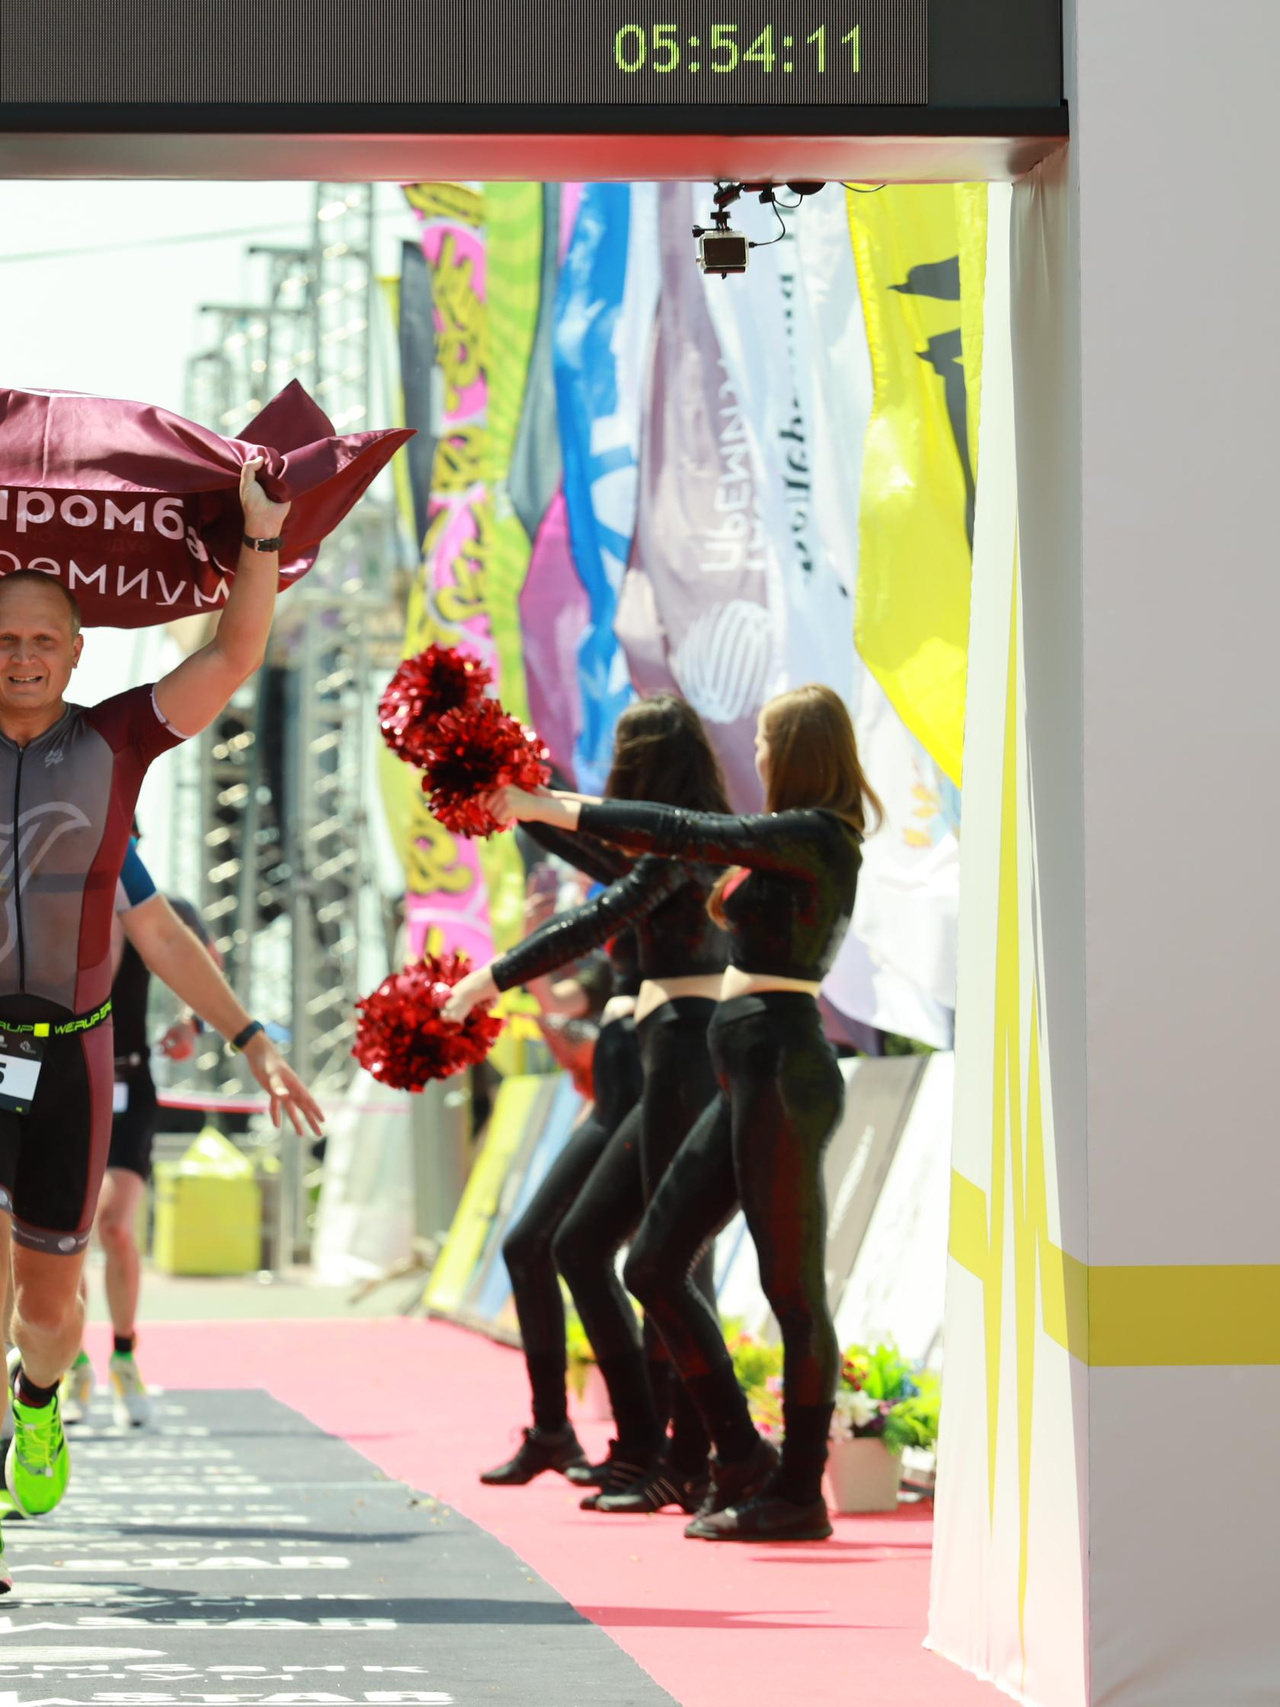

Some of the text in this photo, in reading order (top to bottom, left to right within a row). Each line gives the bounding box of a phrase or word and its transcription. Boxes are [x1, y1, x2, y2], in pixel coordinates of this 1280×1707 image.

[614, 23, 861, 73] 05:54:11
[54, 1012, 101, 1035] WERUP
[76, 1616, 398, 1627] STAR
[90, 1690, 456, 1703] STAR
